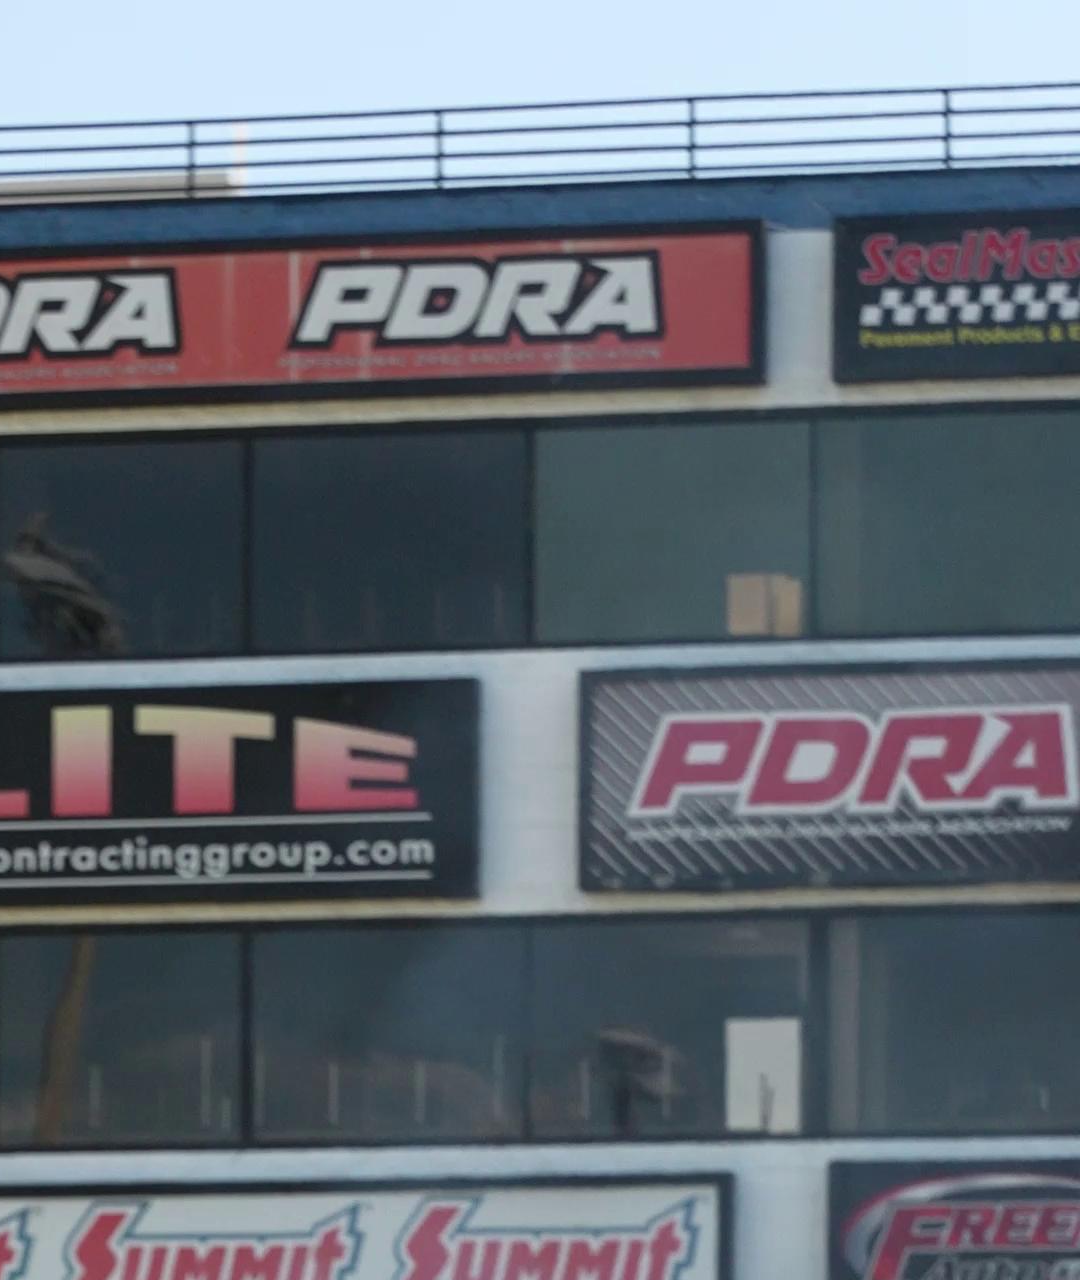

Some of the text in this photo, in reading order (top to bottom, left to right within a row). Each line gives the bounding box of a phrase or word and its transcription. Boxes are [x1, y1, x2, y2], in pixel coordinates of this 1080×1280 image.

[291, 253, 660, 346] PDRA
[858, 226, 1080, 285] SealMas
[632, 706, 1074, 814] PDRA
